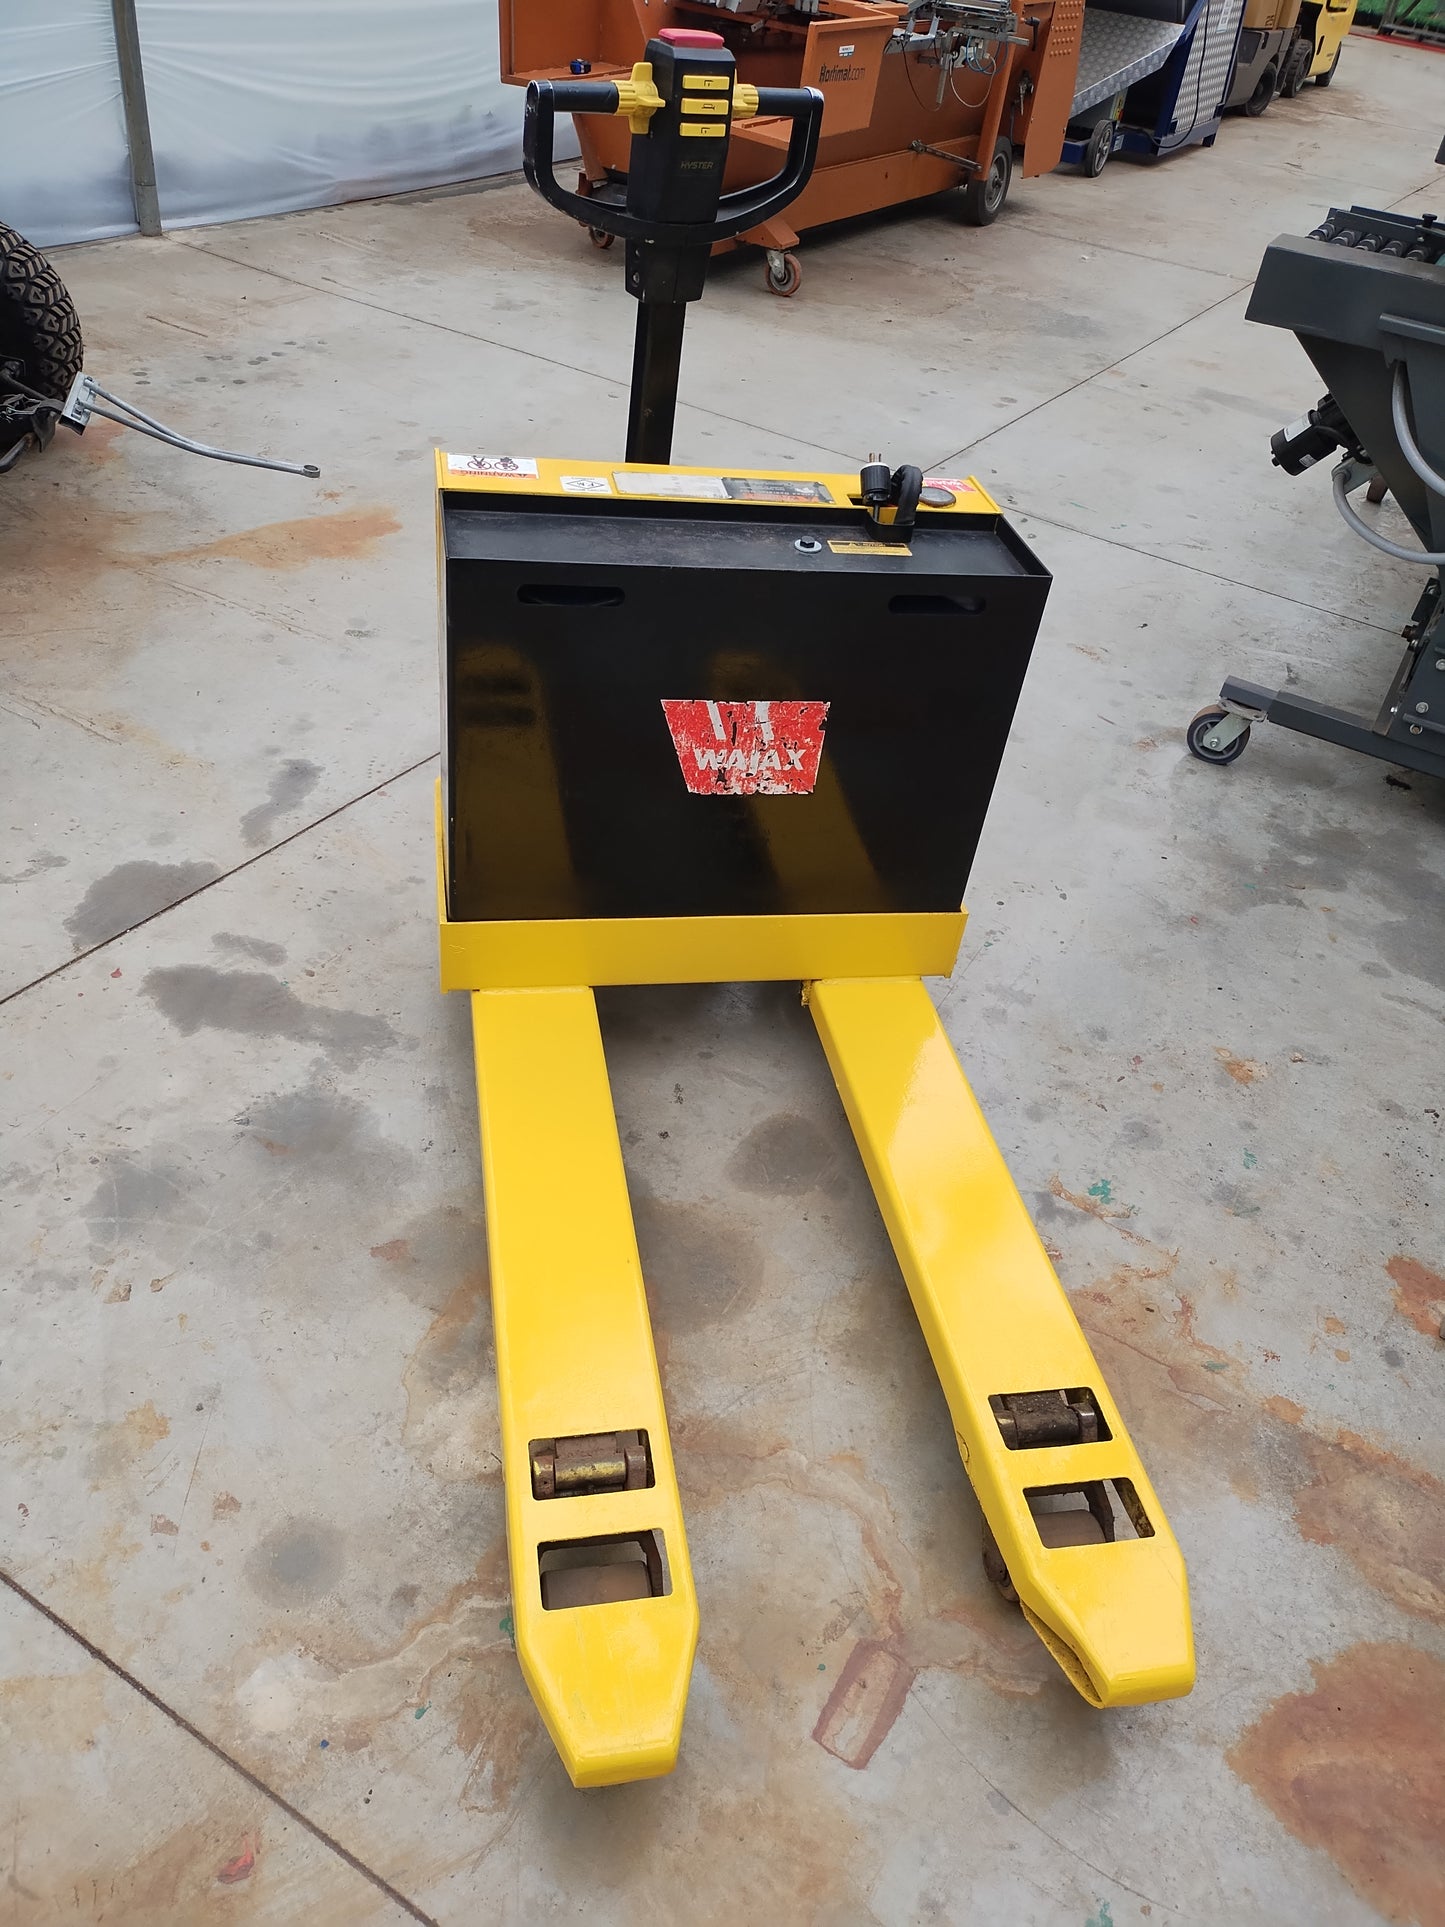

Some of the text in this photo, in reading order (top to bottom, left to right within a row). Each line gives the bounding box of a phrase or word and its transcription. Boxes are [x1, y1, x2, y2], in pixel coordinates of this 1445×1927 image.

[680, 160, 714, 170] HYSTER
[460, 470, 515, 478] WARNING
[693, 749, 806, 777] WAJAX
